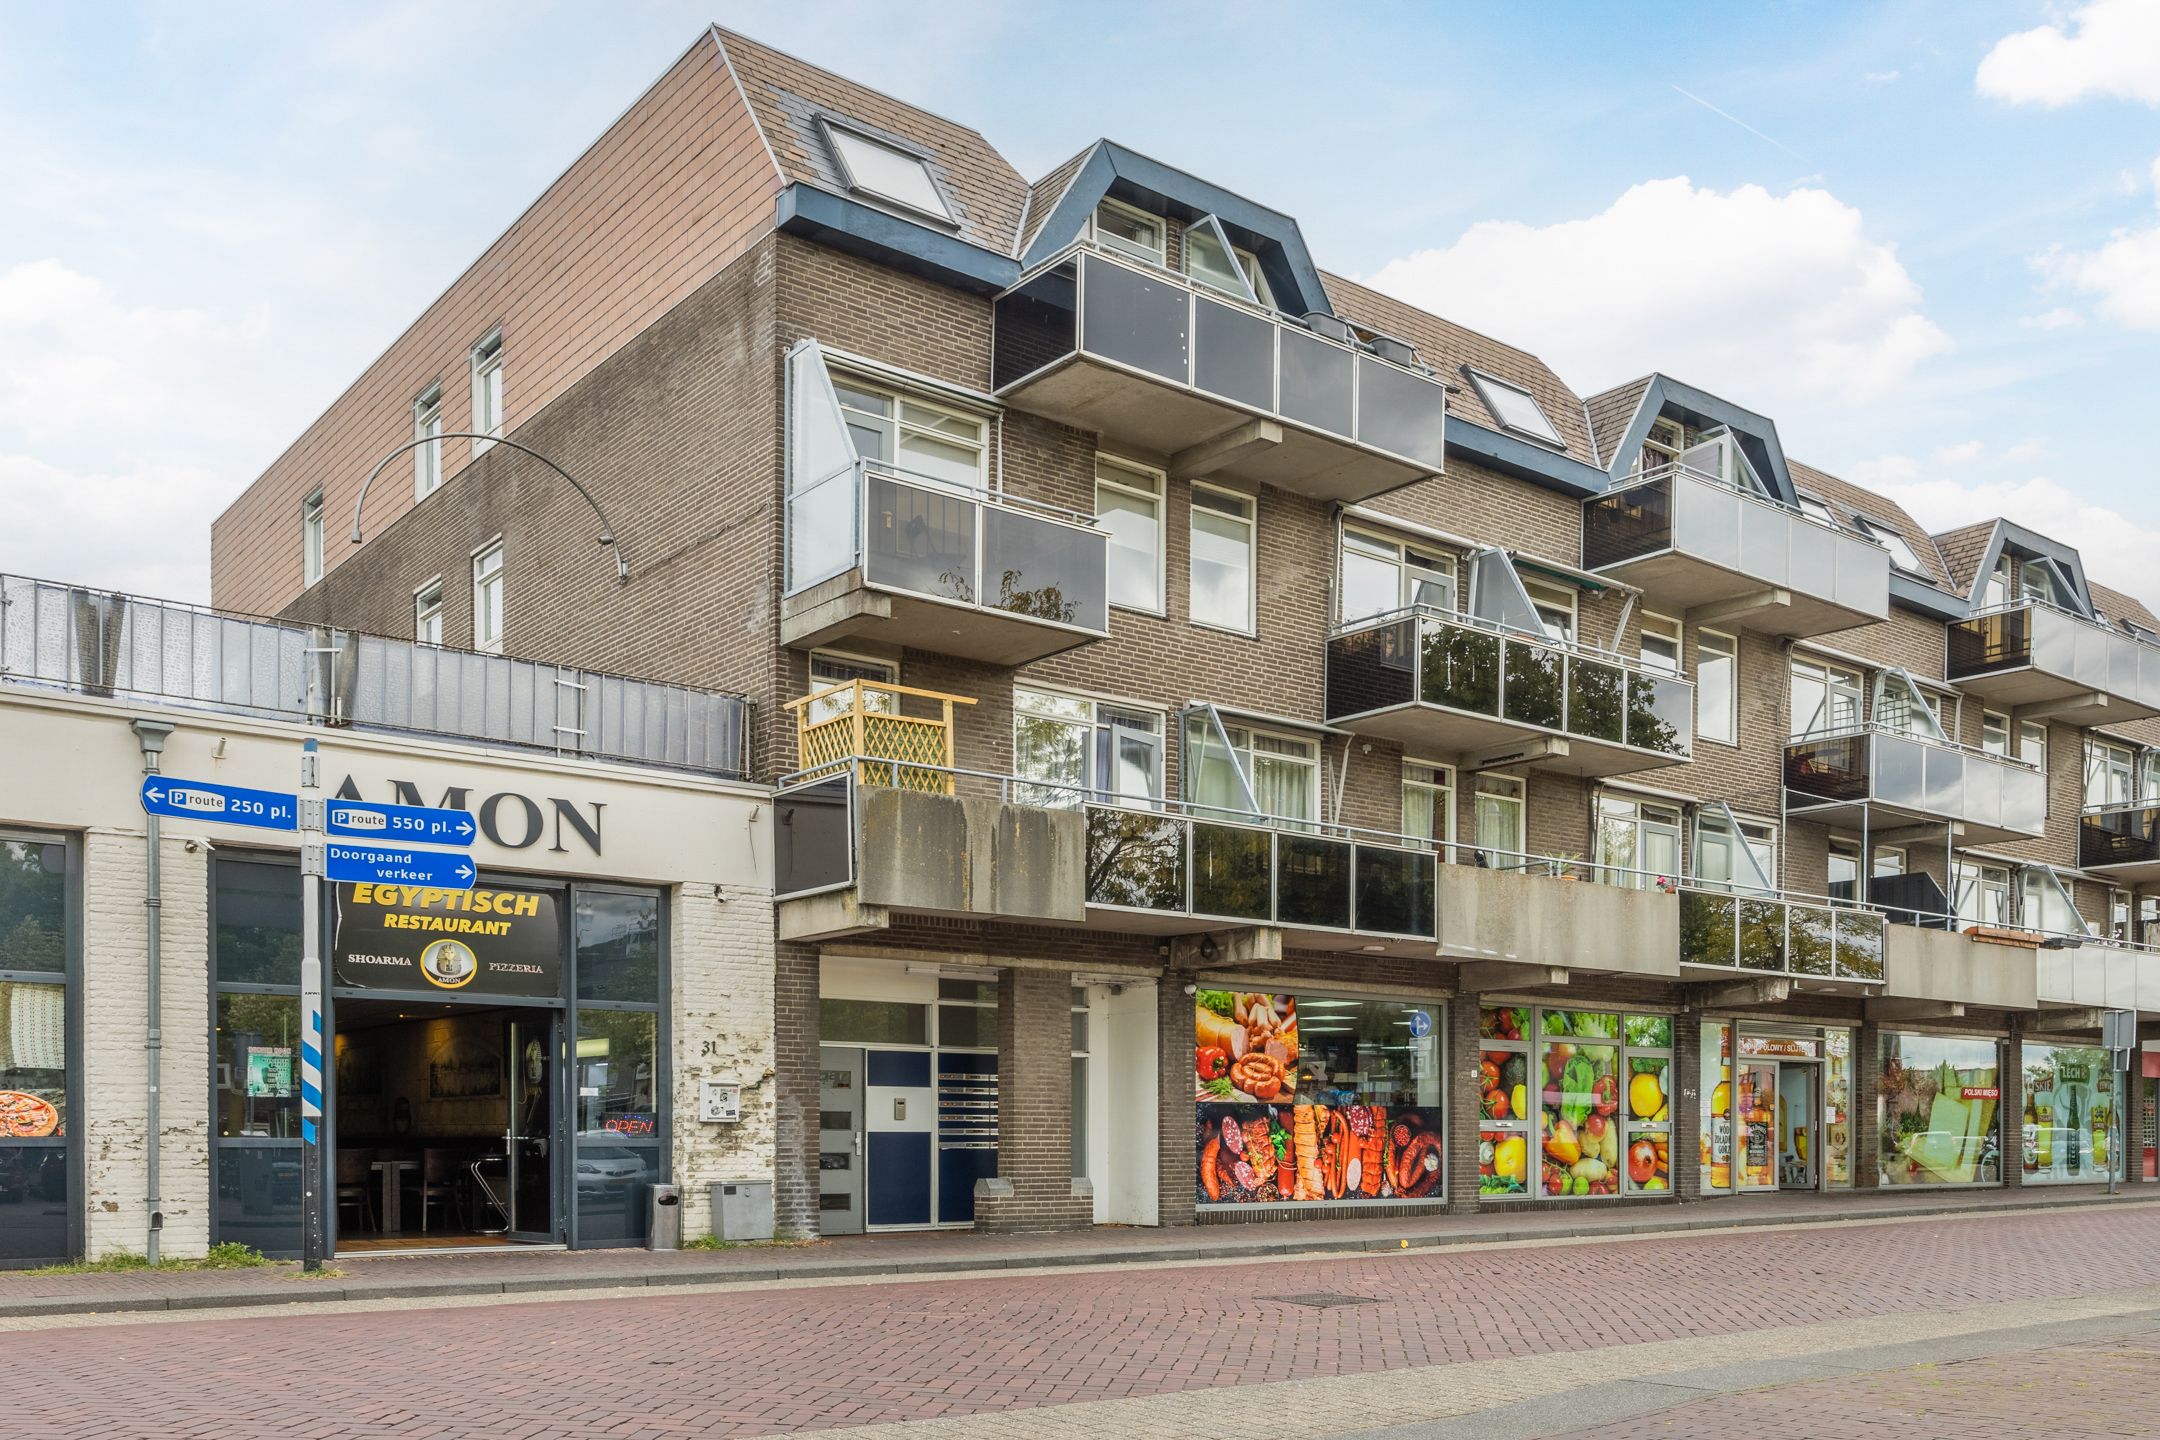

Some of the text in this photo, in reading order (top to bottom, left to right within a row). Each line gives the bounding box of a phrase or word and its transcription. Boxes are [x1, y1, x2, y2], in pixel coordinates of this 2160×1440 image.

[174, 792, 292, 819] P route 250 pl.
[337, 813, 452, 834] P route 550 pl.
[330, 848, 412, 865] Doorgaand
[376, 867, 433, 881] verkeer
[352, 883, 540, 917] EGYPTISCH
[384, 913, 512, 936] RESTAURANT
[348, 953, 412, 966] SHOARMA
[489, 962, 544, 974] PIZZERIA
[701, 1040, 716, 1057] 31
[2062, 1066, 2081, 1079] LECH
[1964, 1088, 1982, 1096] POLSKI
[605, 1119, 653, 1134] OPEN
